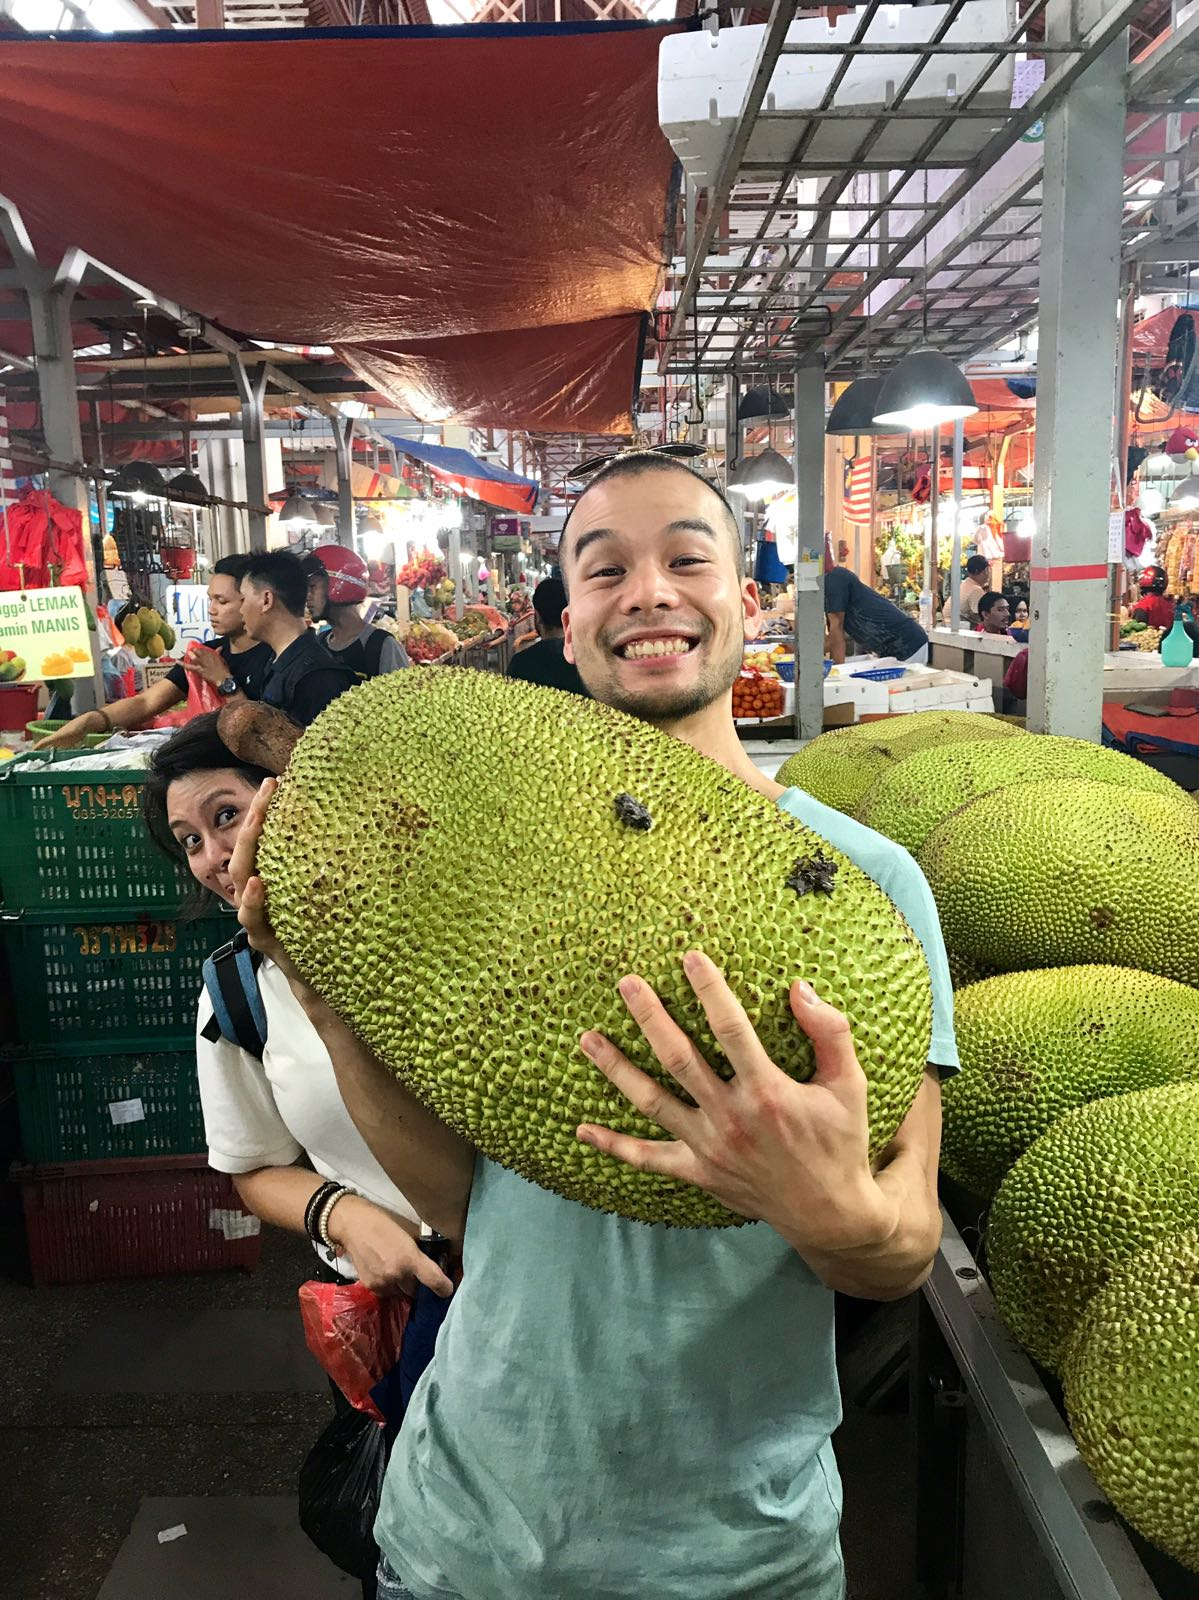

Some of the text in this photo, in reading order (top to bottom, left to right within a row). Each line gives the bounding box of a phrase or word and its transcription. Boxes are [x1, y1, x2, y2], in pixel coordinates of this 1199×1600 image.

[0, 595, 78, 618] gga LEMAK
[32, 617, 80, 634] MANIS
